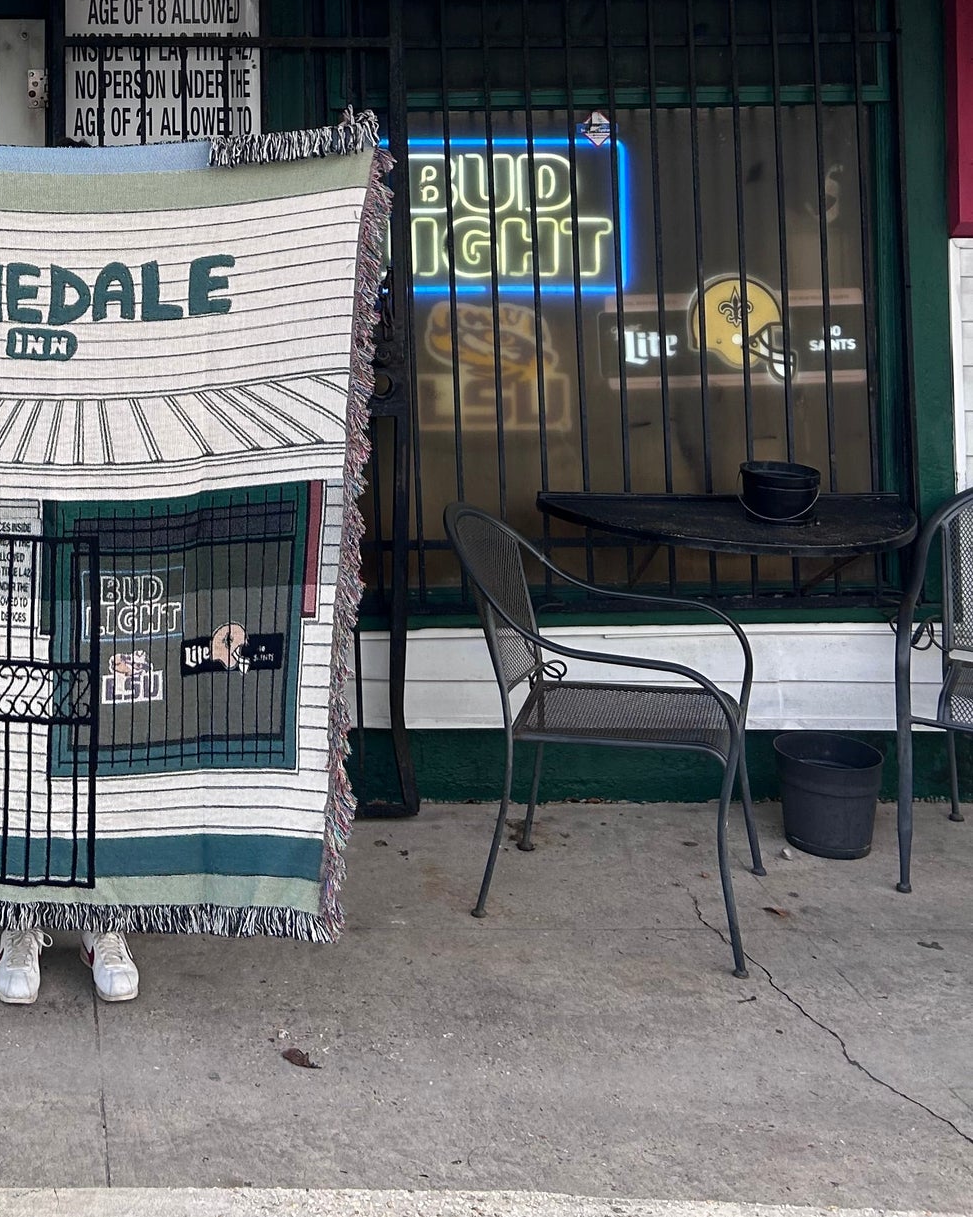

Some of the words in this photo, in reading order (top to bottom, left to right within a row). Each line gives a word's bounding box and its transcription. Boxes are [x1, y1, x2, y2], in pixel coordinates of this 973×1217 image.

[75, 70, 97, 99] NO
[231, 69, 250, 98] THE
[111, 107, 131, 136] OF
[237, 106, 252, 135] TO
[407, 153, 576, 213] BUD
[388, 215, 614, 278] IGHT
[13, 331, 69, 356] INN
[624, 330, 678, 364] Lite
[809, 338, 856, 351] SANTS
[11, 522, 32, 533] INSIDE
[100, 574, 165, 605] BUD
[185, 646, 210, 668] Lite
